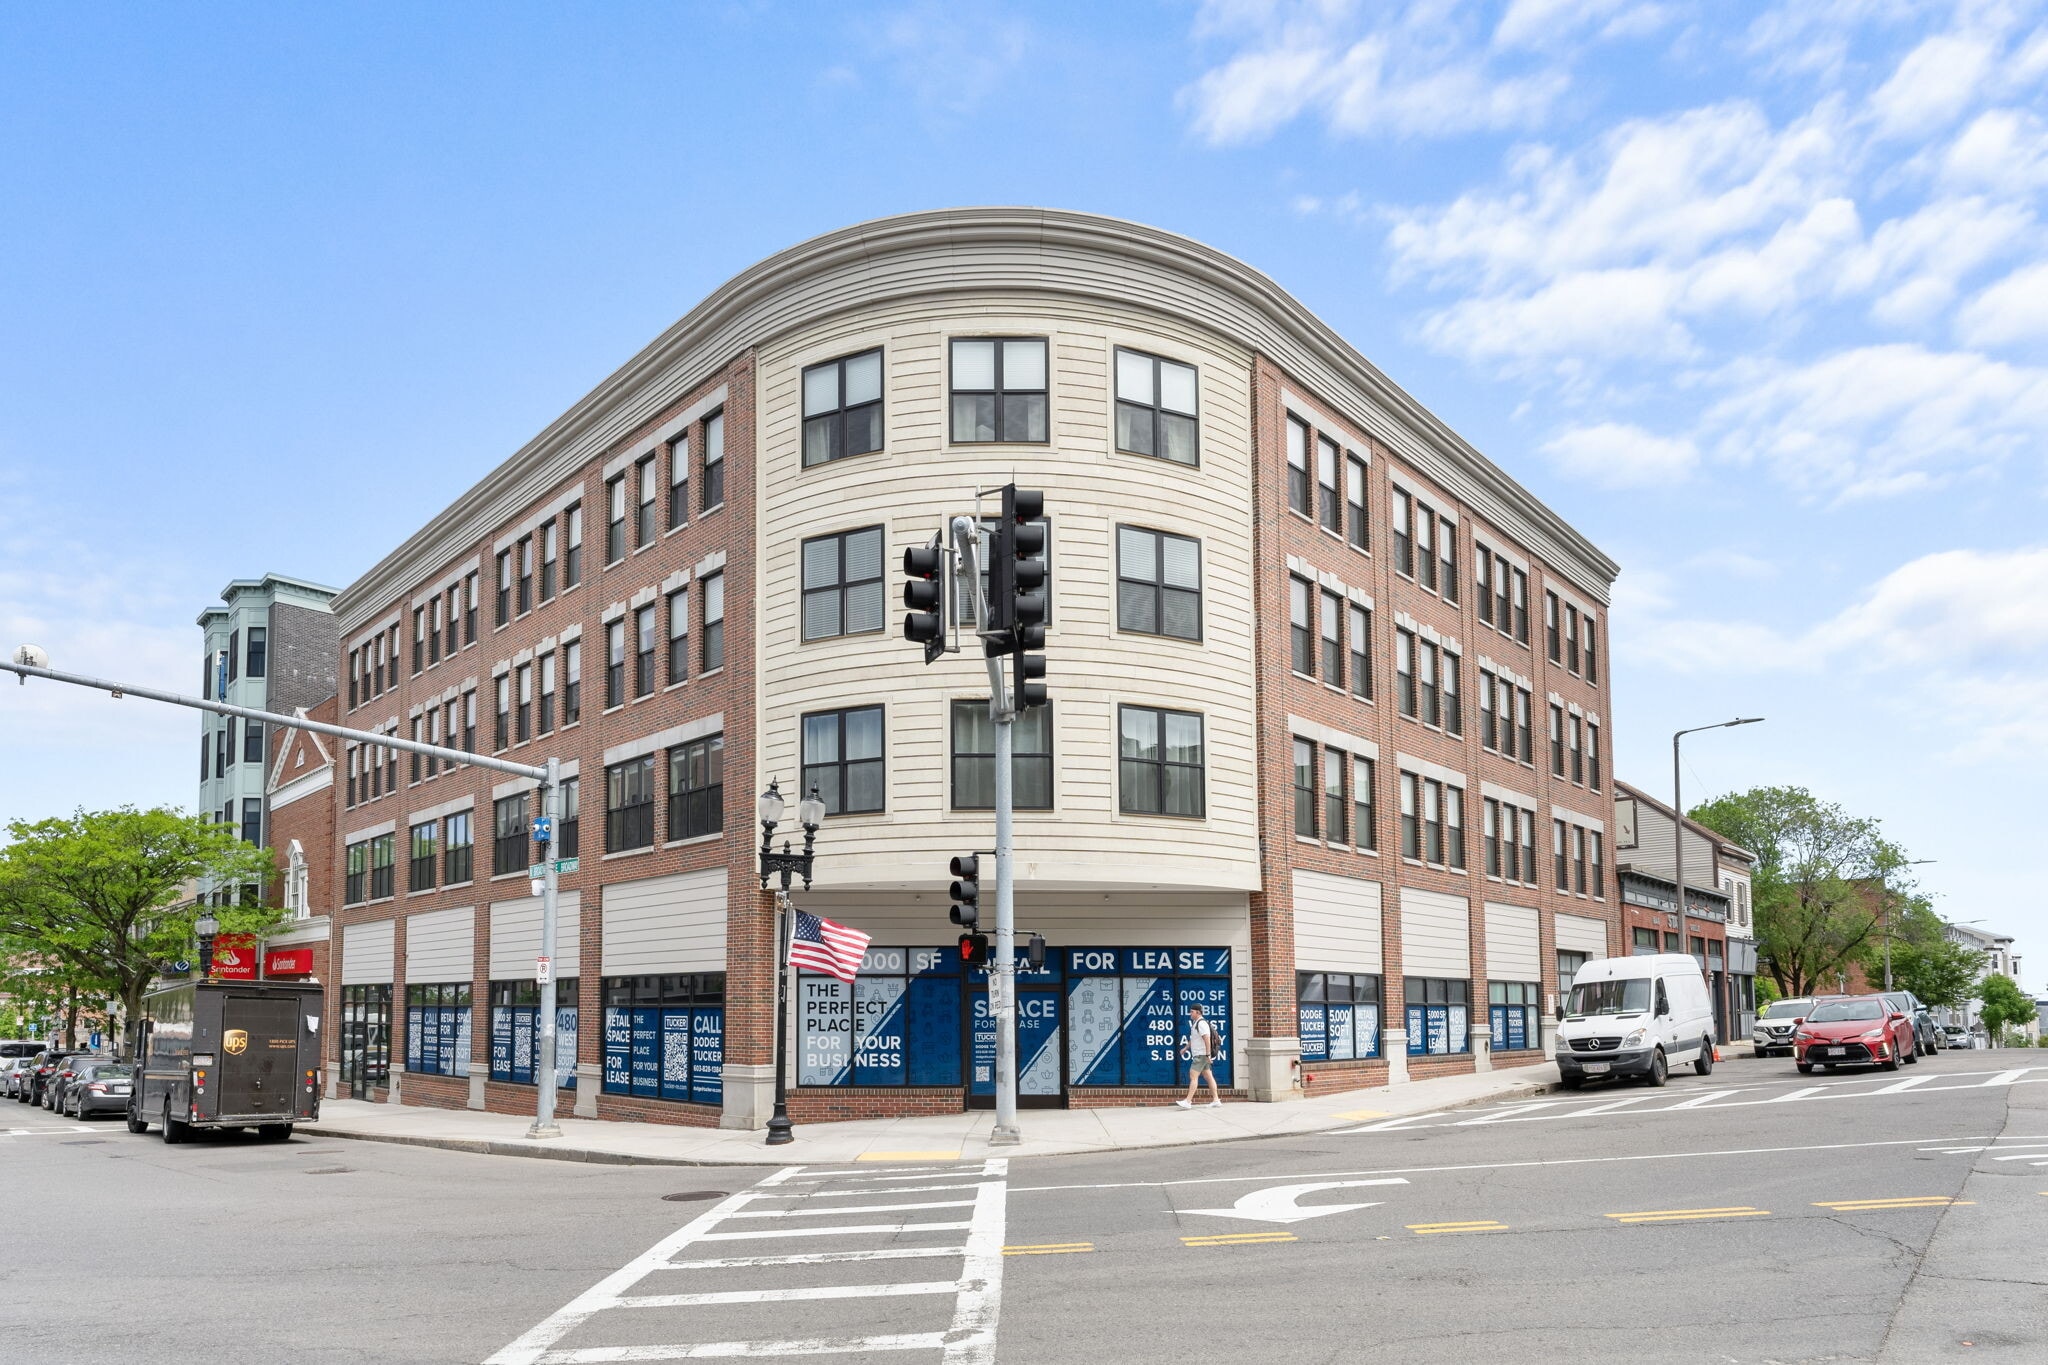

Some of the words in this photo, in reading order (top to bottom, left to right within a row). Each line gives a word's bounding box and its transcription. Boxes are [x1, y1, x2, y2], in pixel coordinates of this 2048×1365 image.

[277, 959, 296, 970] Santander
[917, 952, 942, 970] SF
[978, 957, 1051, 975] RAL
[1072, 952, 1115, 970] FOR
[1132, 952, 1205, 970] LEASE
[807, 984, 839, 997] THE
[1162, 990, 1206, 1002] 5,000
[1209, 990, 1225, 1001] SF
[807, 1001, 887, 1014] PERFECT
[1147, 1005, 1226, 1016] AVAILBLE
[425, 1013, 437, 1024] CALL
[633, 1015, 644, 1024] THE
[1300, 1010, 1323, 1019] DODGE
[1357, 1009, 1374, 1019] RETAIL
[1449, 1010, 1464, 1024] 480
[558, 1014, 577, 1031] 480
[607, 1015, 630, 1027] RETAIL
[666, 1018, 687, 1027] TUCKER
[693, 1015, 722, 1034] CALL
[807, 1019, 865, 1032] PLACE
[974, 1020, 996, 1029] FOR
[1149, 1020, 1174, 1031] 480
[1300, 1022, 1325, 1031] TUCKER
[441, 1025, 450, 1035] FOR
[633, 1031, 656, 1040] PERFECT
[1329, 1025, 1350, 1037] SQFT
[1357, 1031, 1369, 1040] FOR
[558, 1034, 576, 1046] WEST
[607, 1030, 630, 1042] SPACE
[1146, 1035, 1227, 1046] BROAY
[225, 1037, 246, 1051] ups
[693, 1036, 719, 1048] DODGE
[807, 1036, 841, 1050] FOR
[856, 1036, 901, 1050] YOUR
[1302, 1043, 1324, 1052] TUCKER
[1428, 1037, 1446, 1049] LEASE
[493, 1047, 506, 1058] FOR
[633, 1046, 650, 1055] PLACE
[693, 1050, 722, 1062] TUCKER
[1151, 1050, 1162, 1061] S.
[558, 1056, 576, 1066] SOUTH
[606, 1056, 622, 1068] FOR
[807, 1053, 901, 1067] BUSINESS
[493, 1060, 511, 1072] LEASE
[633, 1061, 644, 1070] FOR
[645, 1062, 658, 1071] YOUR
[606, 1071, 630, 1084] LEASE
[633, 1077, 658, 1087] BUSINESS
